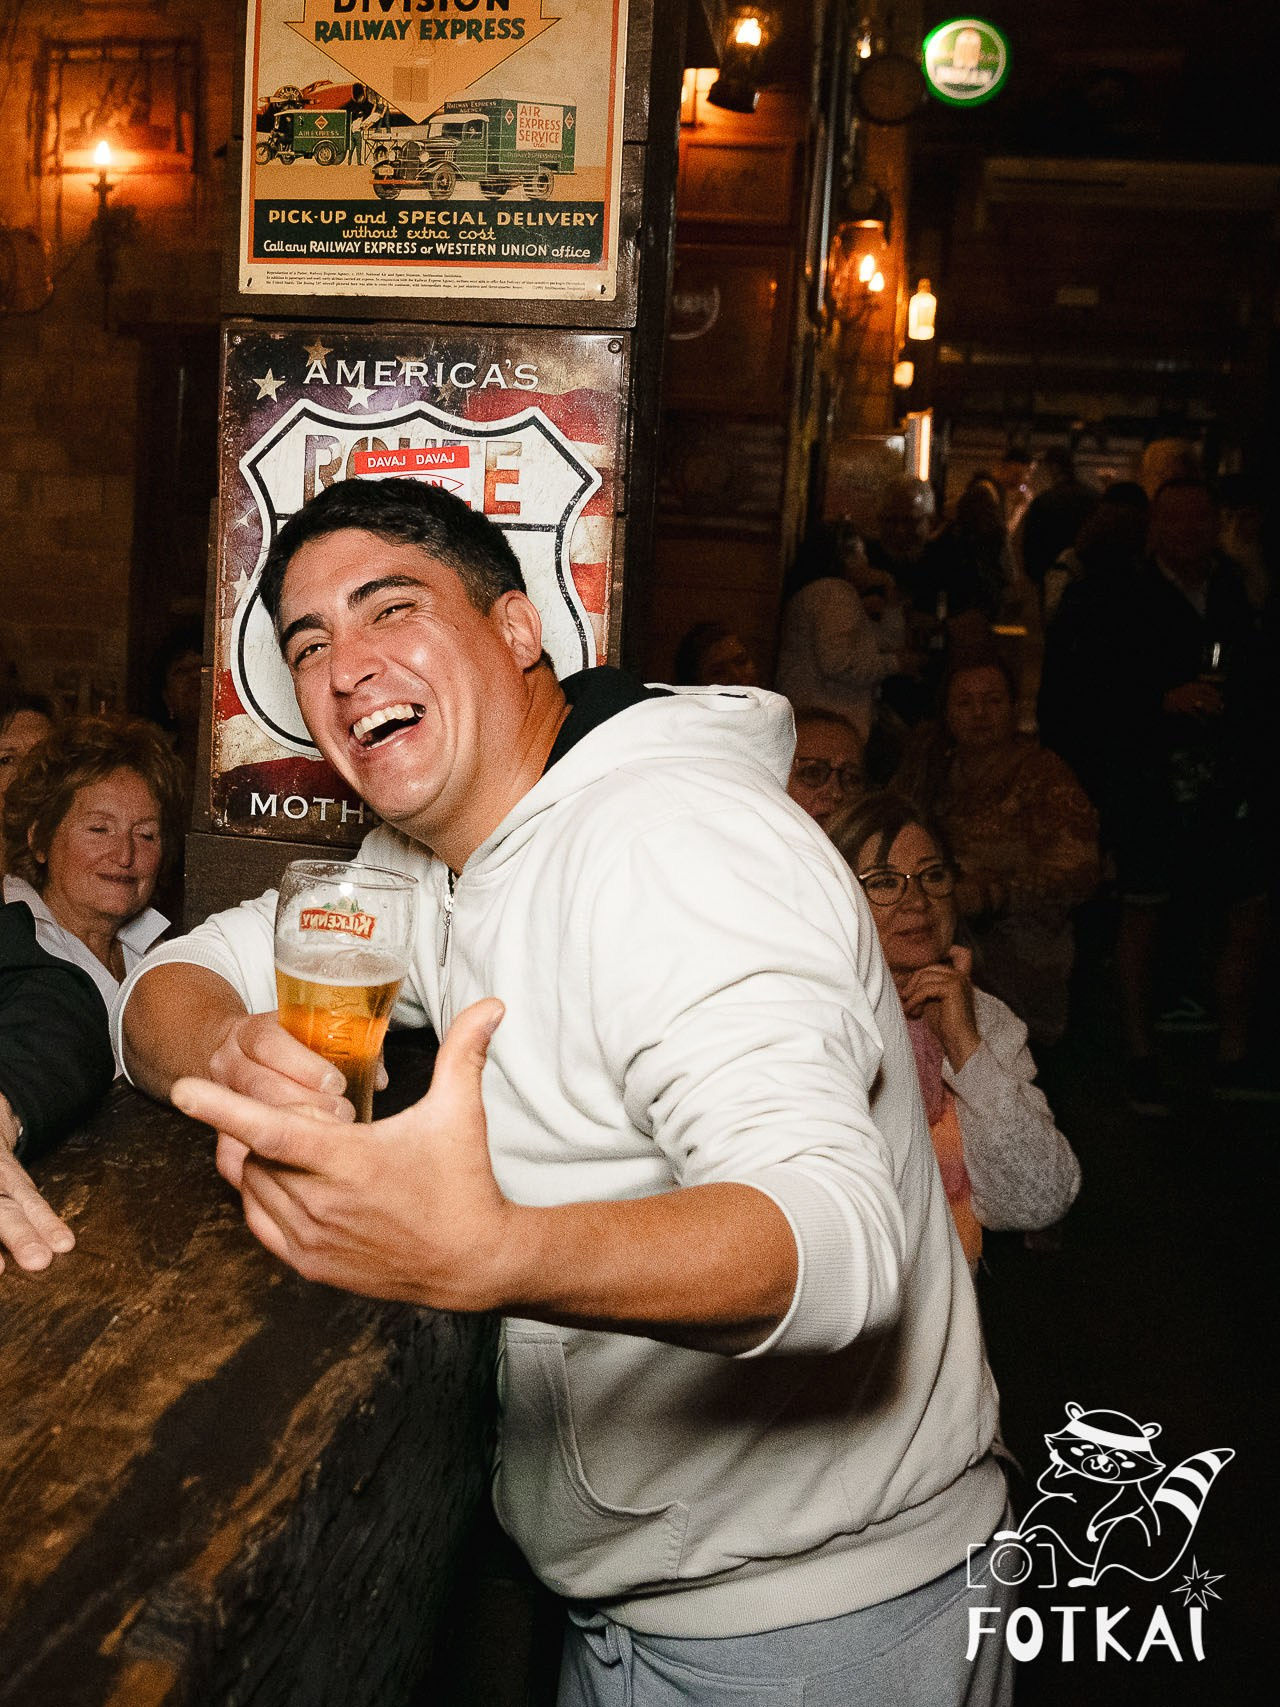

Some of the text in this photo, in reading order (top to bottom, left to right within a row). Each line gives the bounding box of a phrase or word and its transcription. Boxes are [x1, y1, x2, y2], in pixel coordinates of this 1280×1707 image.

[315, 17, 526, 43] RAILWAY EXPRESS
[520, 105, 541, 117] AIR
[519, 117, 561, 131] EXPRESS
[518, 129, 560, 144] SERVICE
[269, 209, 599, 226] PICK-UP and SPECIAL DELIVERY
[342, 226, 497, 241] without extra cost
[263, 240, 591, 258] Call any RAILWAY EXPRESS or WESTERN UNION office
[302, 358, 540, 390] AMERICA'S
[367, 452, 456, 468] DAVAJ DAVAJ
[250, 792, 364, 824] MOTH
